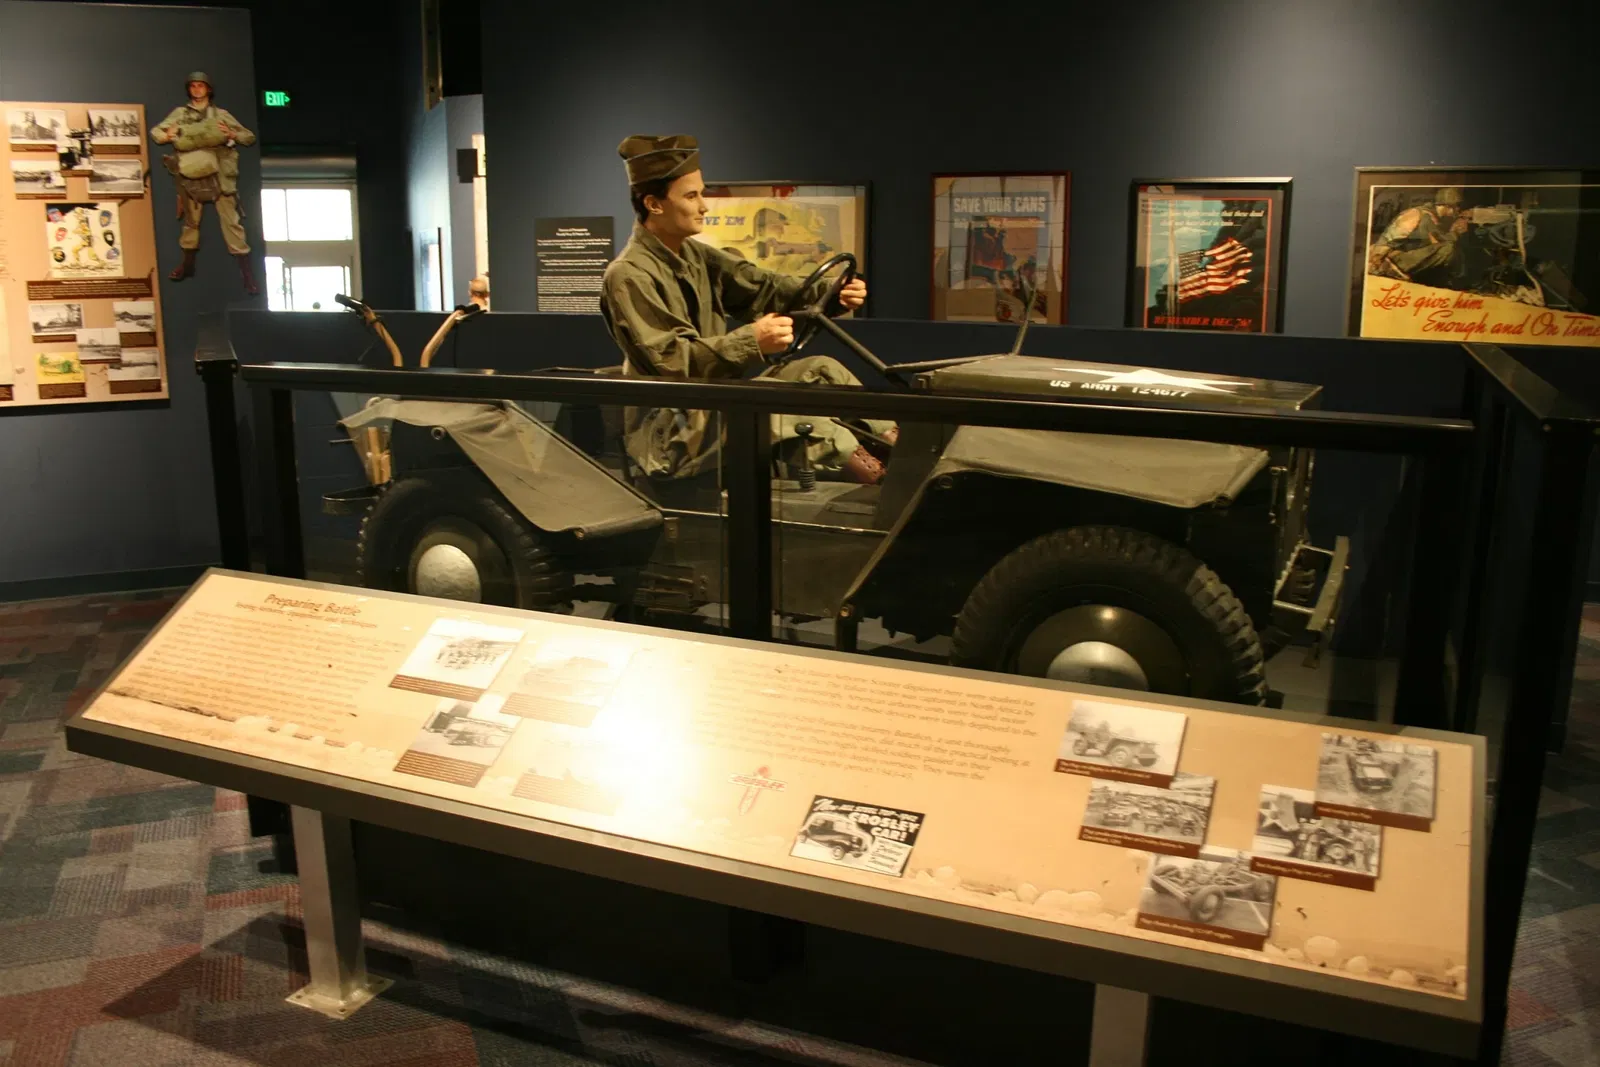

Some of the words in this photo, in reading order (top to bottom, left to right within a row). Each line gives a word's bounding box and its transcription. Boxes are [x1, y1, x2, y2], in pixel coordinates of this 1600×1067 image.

[265, 91, 285, 106] EXIT
[954, 198, 980, 213] SAVE
[983, 197, 1011, 213] YOUR
[1015, 196, 1046, 213] CANS
[1372, 283, 1408, 310] Let's
[1413, 292, 1450, 316] give
[1452, 291, 1484, 310] him
[1422, 310, 1487, 341] Enough
[1490, 314, 1531, 336] and
[1530, 312, 1560, 337] On
[1050, 379, 1071, 388] US
[1080, 382, 1121, 392] ARMY
[323, 602, 362, 617] Battle
[848, 811, 920, 834] CROSLEY
[870, 826, 909, 842] CAR!
